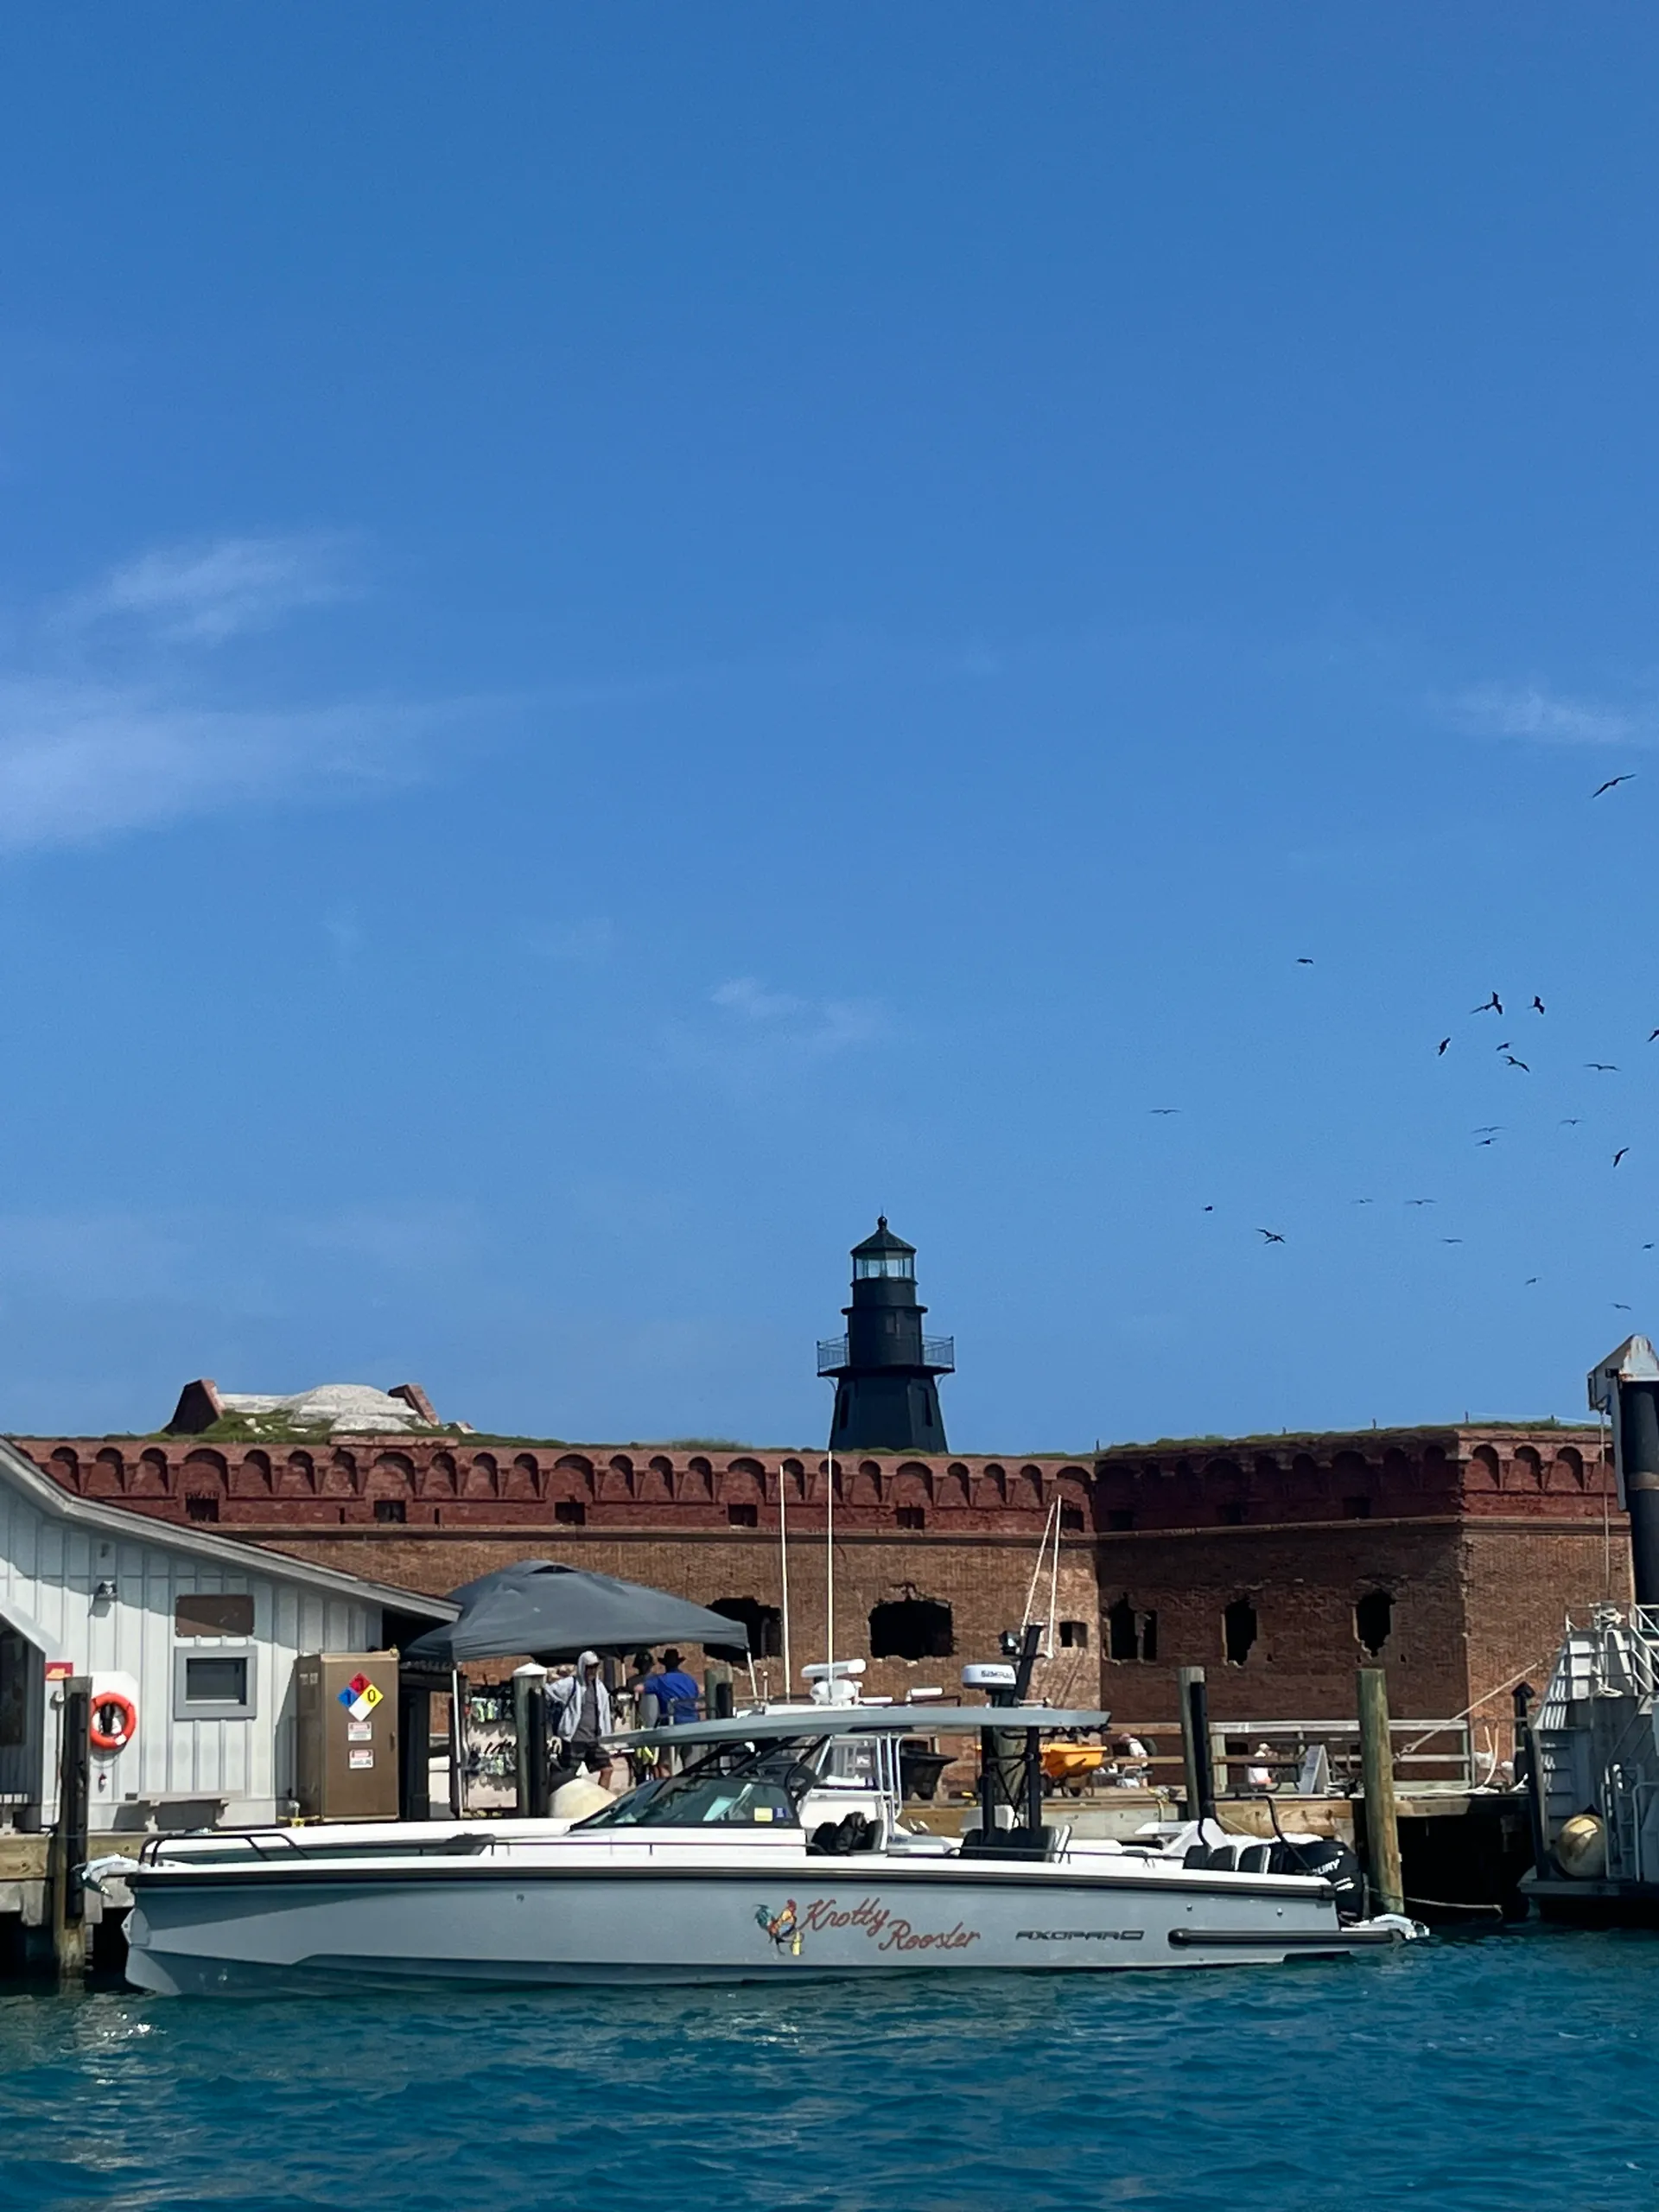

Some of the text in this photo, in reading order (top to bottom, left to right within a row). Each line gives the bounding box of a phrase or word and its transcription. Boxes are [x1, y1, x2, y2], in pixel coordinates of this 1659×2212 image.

[367, 1689, 376, 1703] 0
[798, 1897, 890, 1937] Krotty
[878, 1919, 981, 1951] Rooster
